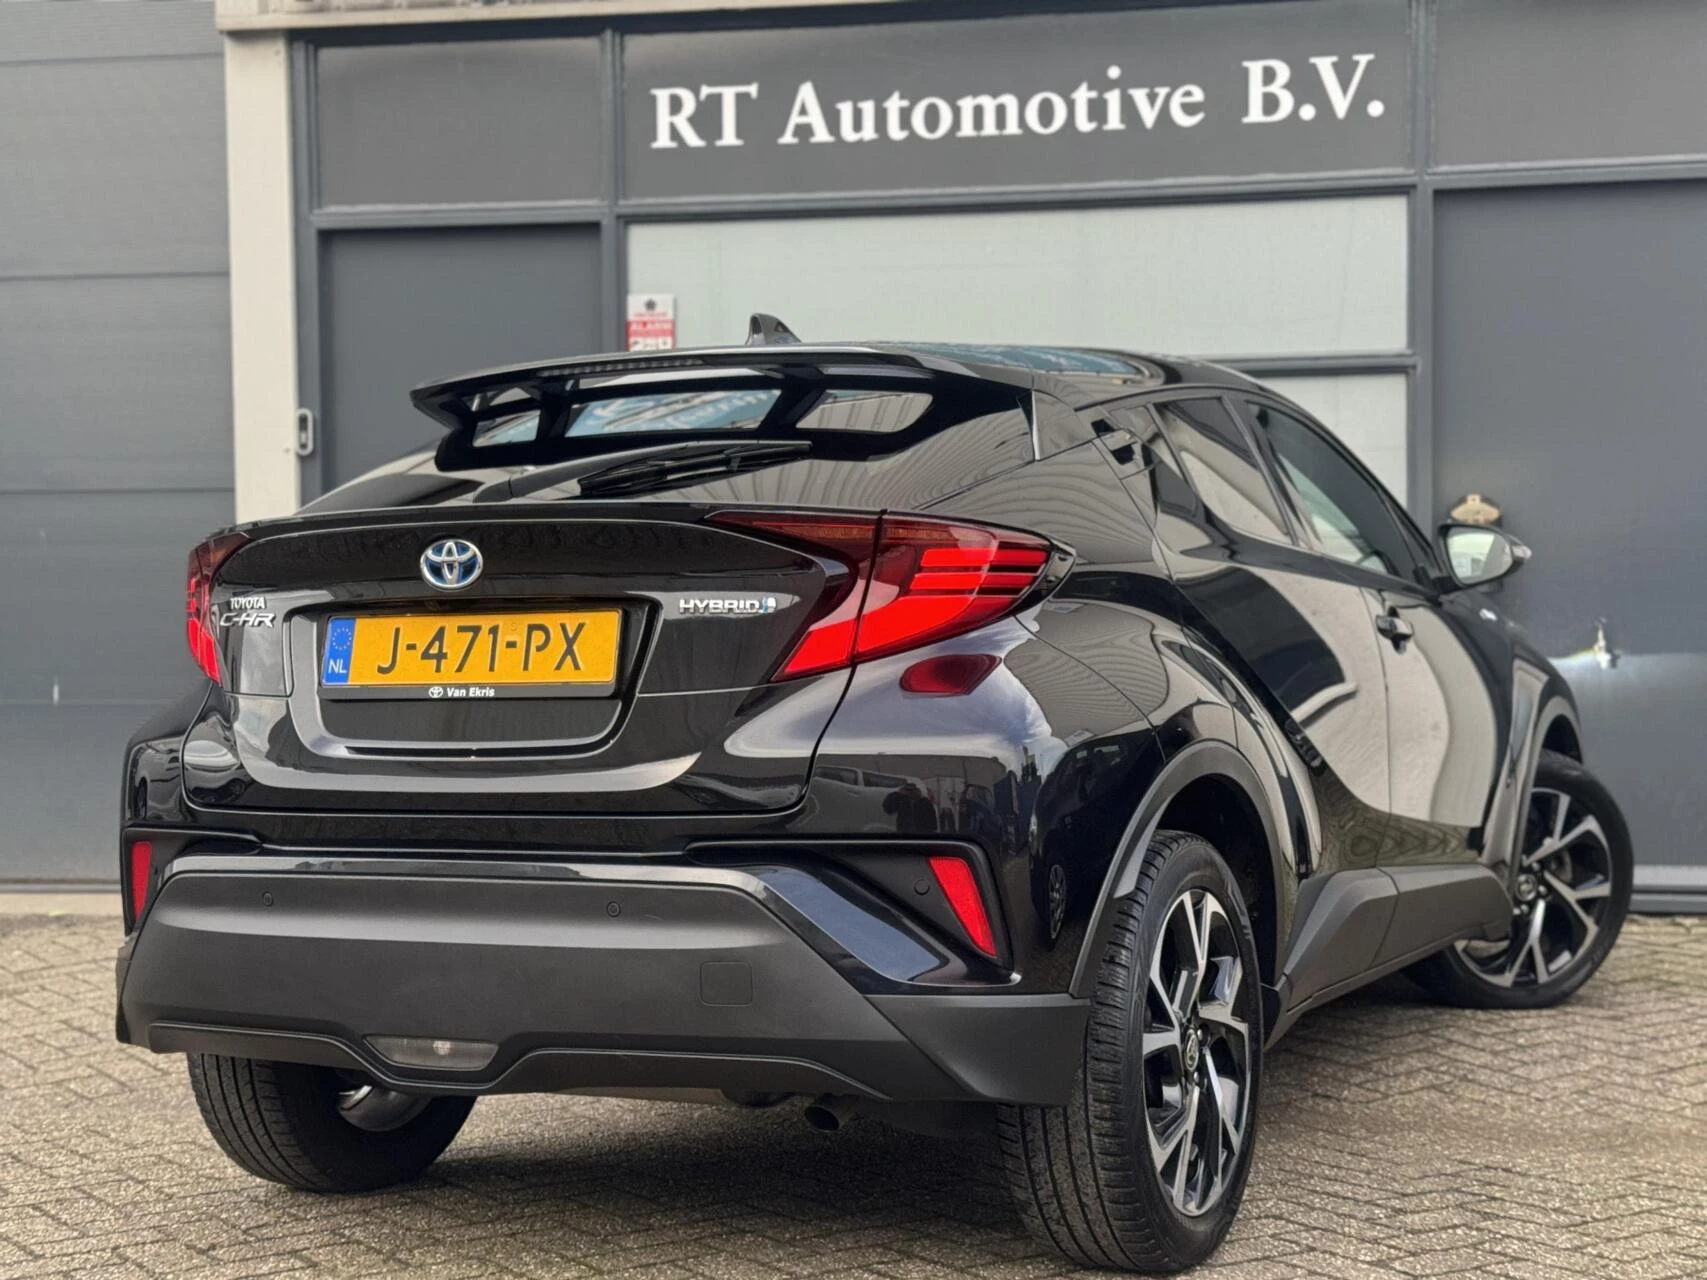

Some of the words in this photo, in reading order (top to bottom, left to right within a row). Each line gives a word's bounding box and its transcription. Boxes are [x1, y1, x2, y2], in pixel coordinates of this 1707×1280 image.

[650, 82, 758, 149] RT
[777, 65, 1205, 144] Automotive
[1241, 53, 1385, 124] B.V.
[230, 596, 266, 609] TOYOTA
[680, 599, 760, 614] HYBRID
[220, 612, 275, 628] C-HR
[377, 622, 586, 675] J-471-PX
[328, 659, 347, 674] NL
[446, 687, 466, 697] Van
[468, 686, 495, 697] Ekris
